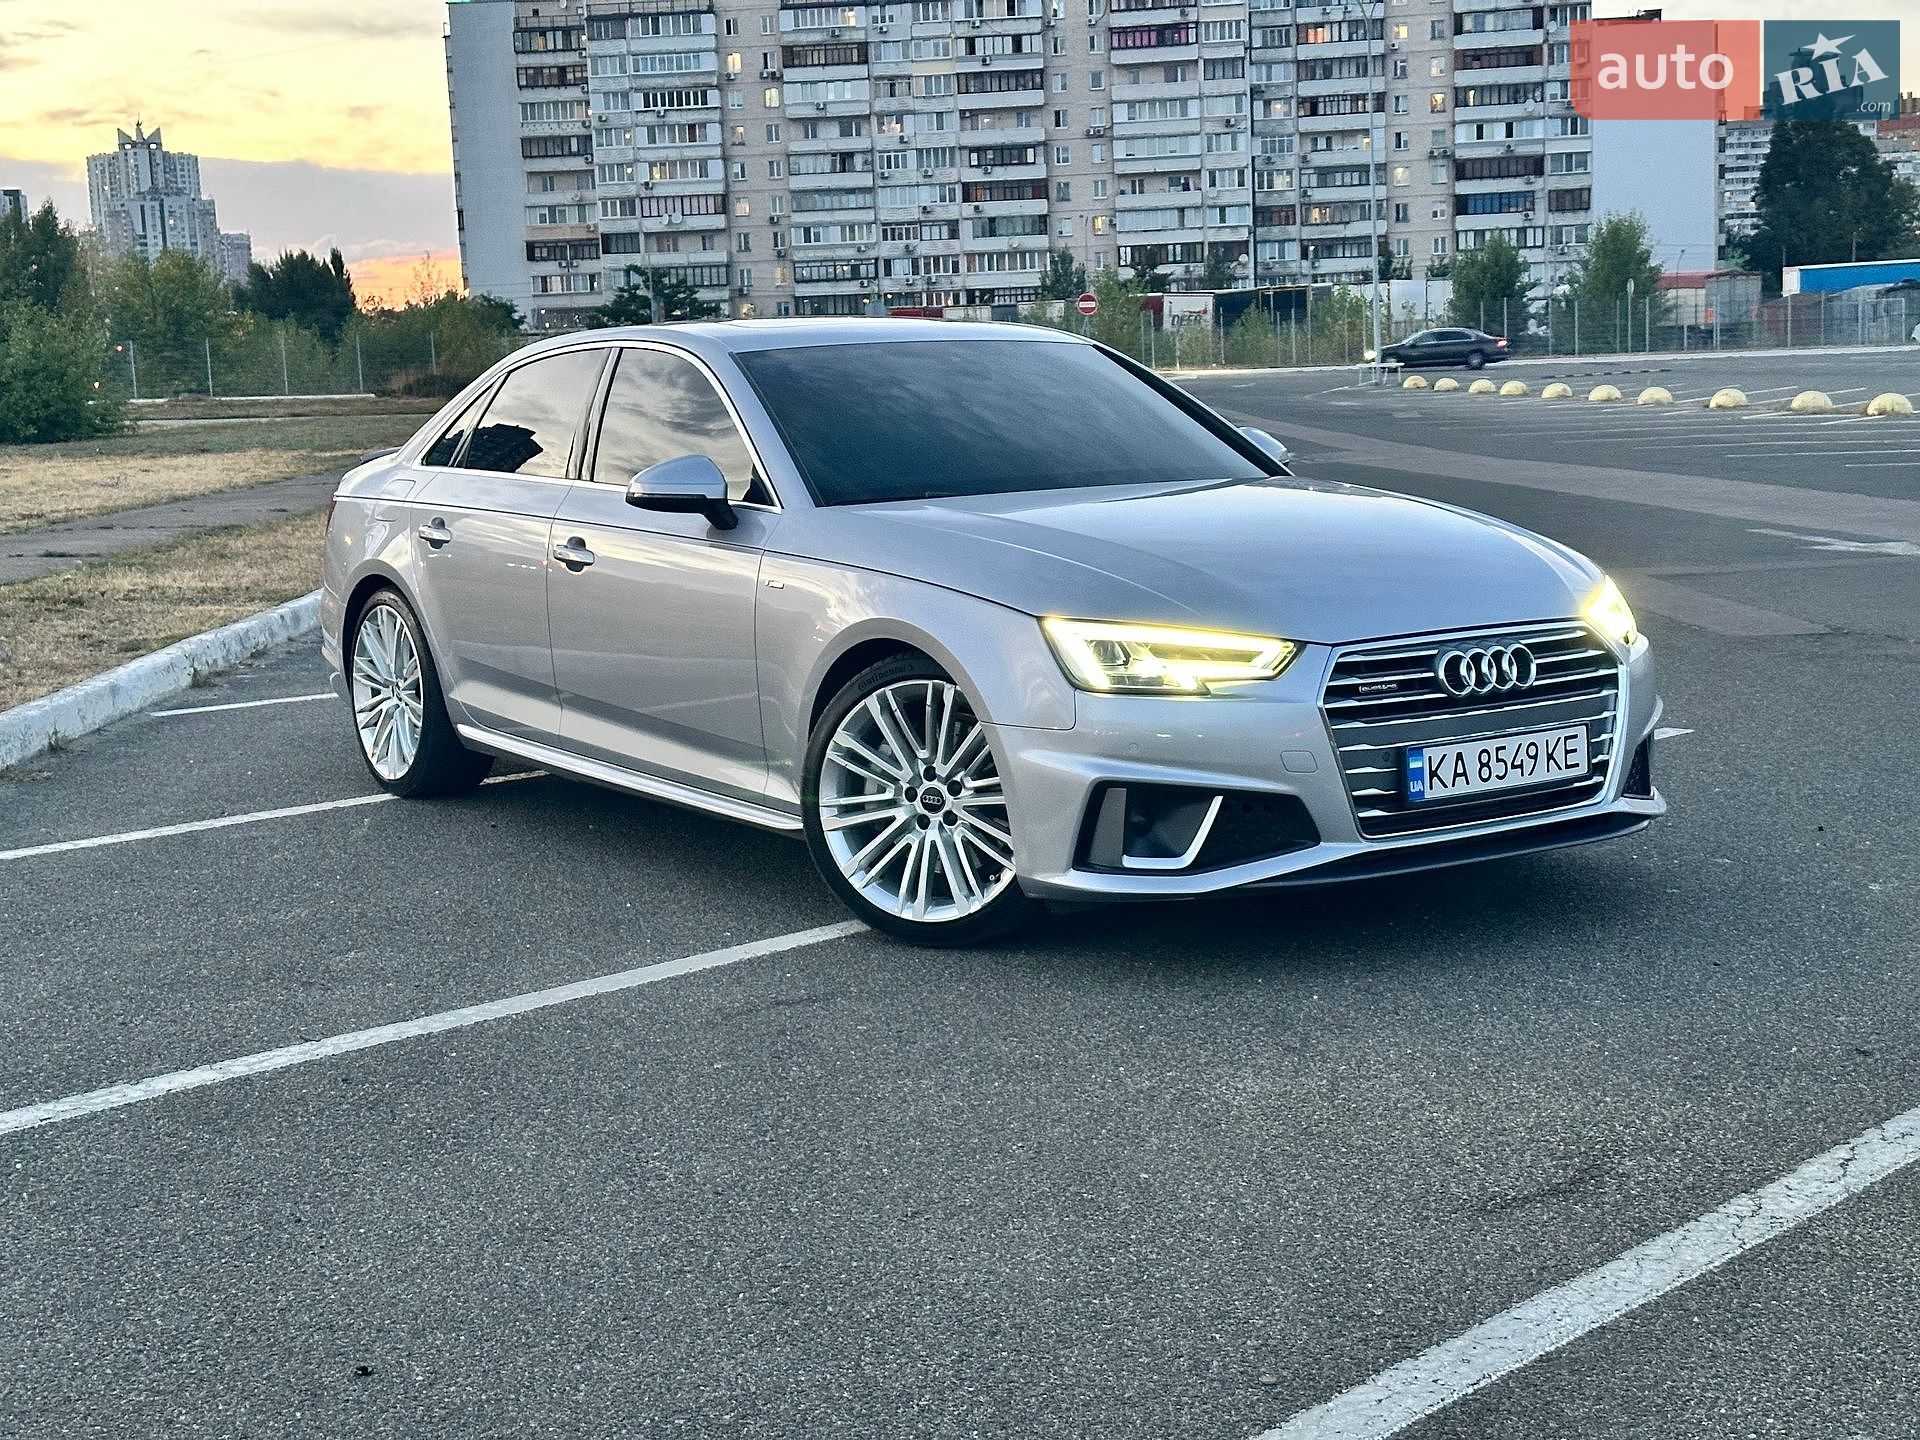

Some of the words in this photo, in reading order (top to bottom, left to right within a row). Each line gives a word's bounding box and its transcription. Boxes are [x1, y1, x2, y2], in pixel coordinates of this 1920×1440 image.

[1427, 752, 1470, 791] KA
[1477, 741, 1539, 783] 8549
[1545, 733, 1580, 773] KE
[1410, 780, 1424, 792] UA
